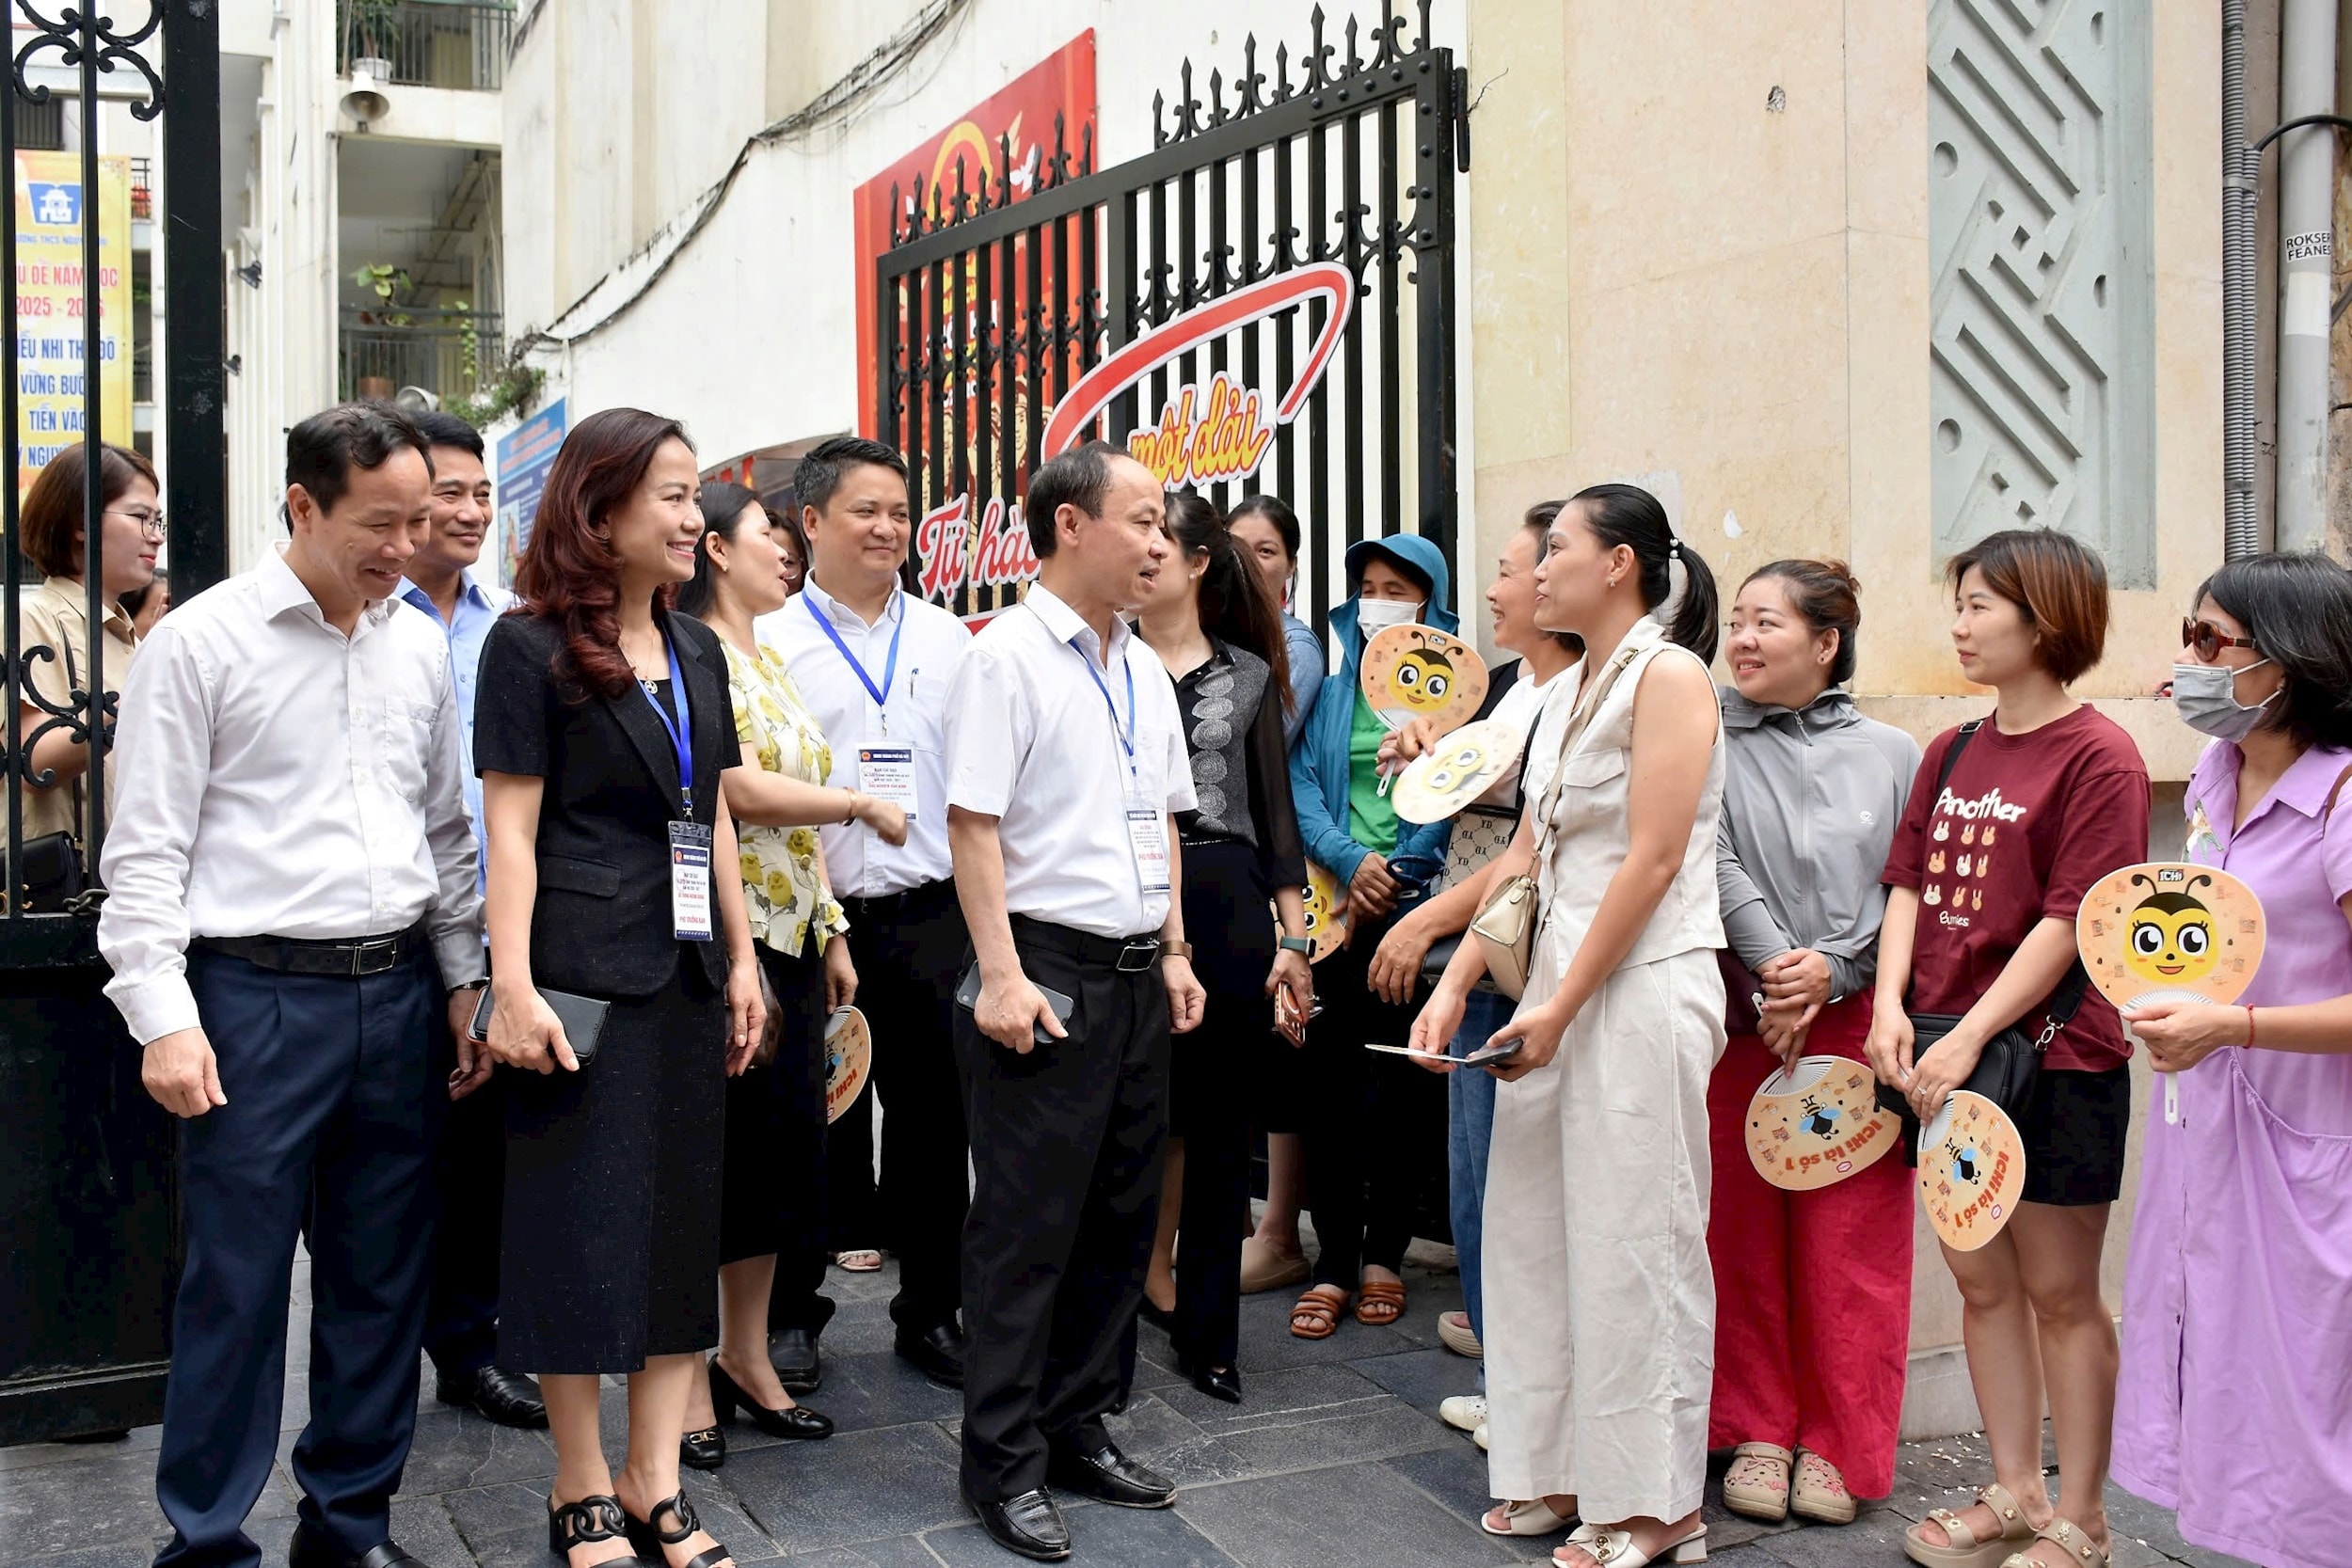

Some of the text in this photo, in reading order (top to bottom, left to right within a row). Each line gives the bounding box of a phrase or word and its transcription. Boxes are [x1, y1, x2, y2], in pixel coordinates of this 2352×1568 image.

[100, 267, 118, 291] ỌC
[16, 295, 51, 316] 2025
[41, 339, 63, 359] NHI
[69, 340, 84, 359] TH
[1191, 377, 1270, 480] dải
[918, 502, 964, 599] Tự
[1932, 786, 2027, 823] Another
